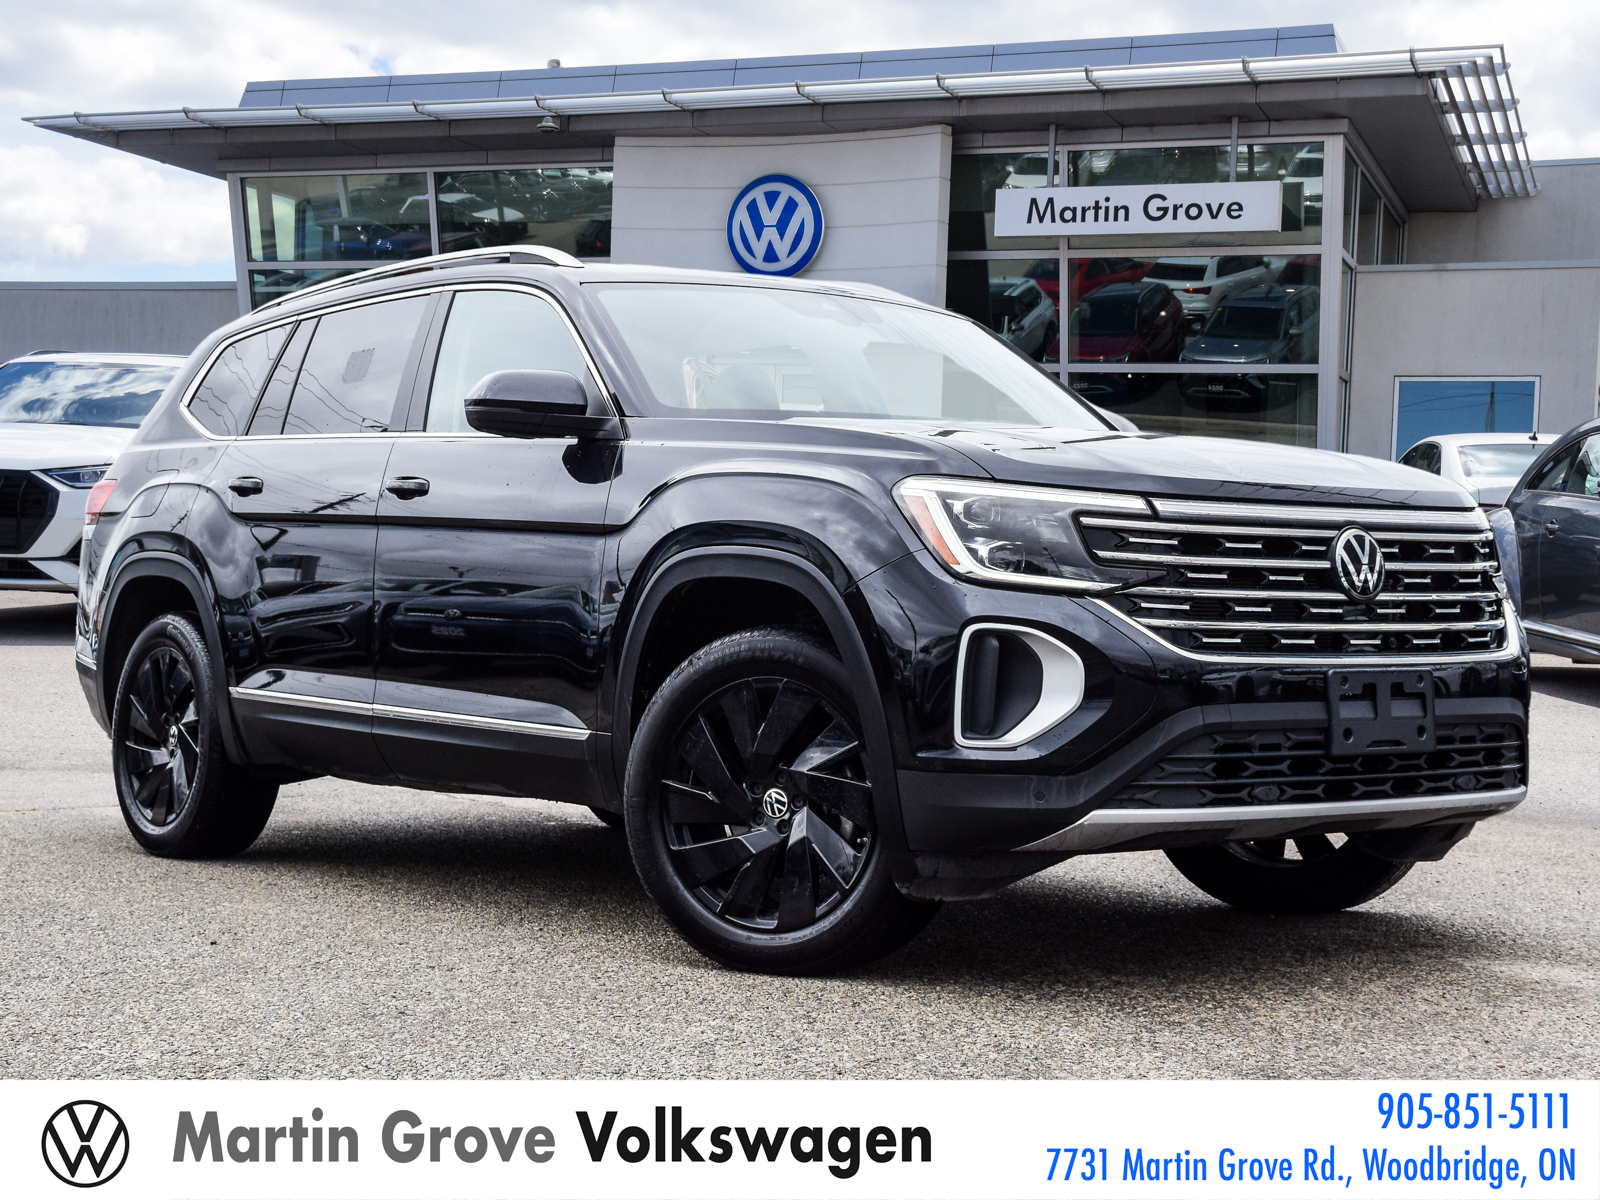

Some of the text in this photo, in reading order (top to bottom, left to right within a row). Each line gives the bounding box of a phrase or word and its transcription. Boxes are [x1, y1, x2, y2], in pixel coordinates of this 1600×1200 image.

[1027, 193, 1244, 224] Martin Grove
[1336, 528, 1385, 598] VW
